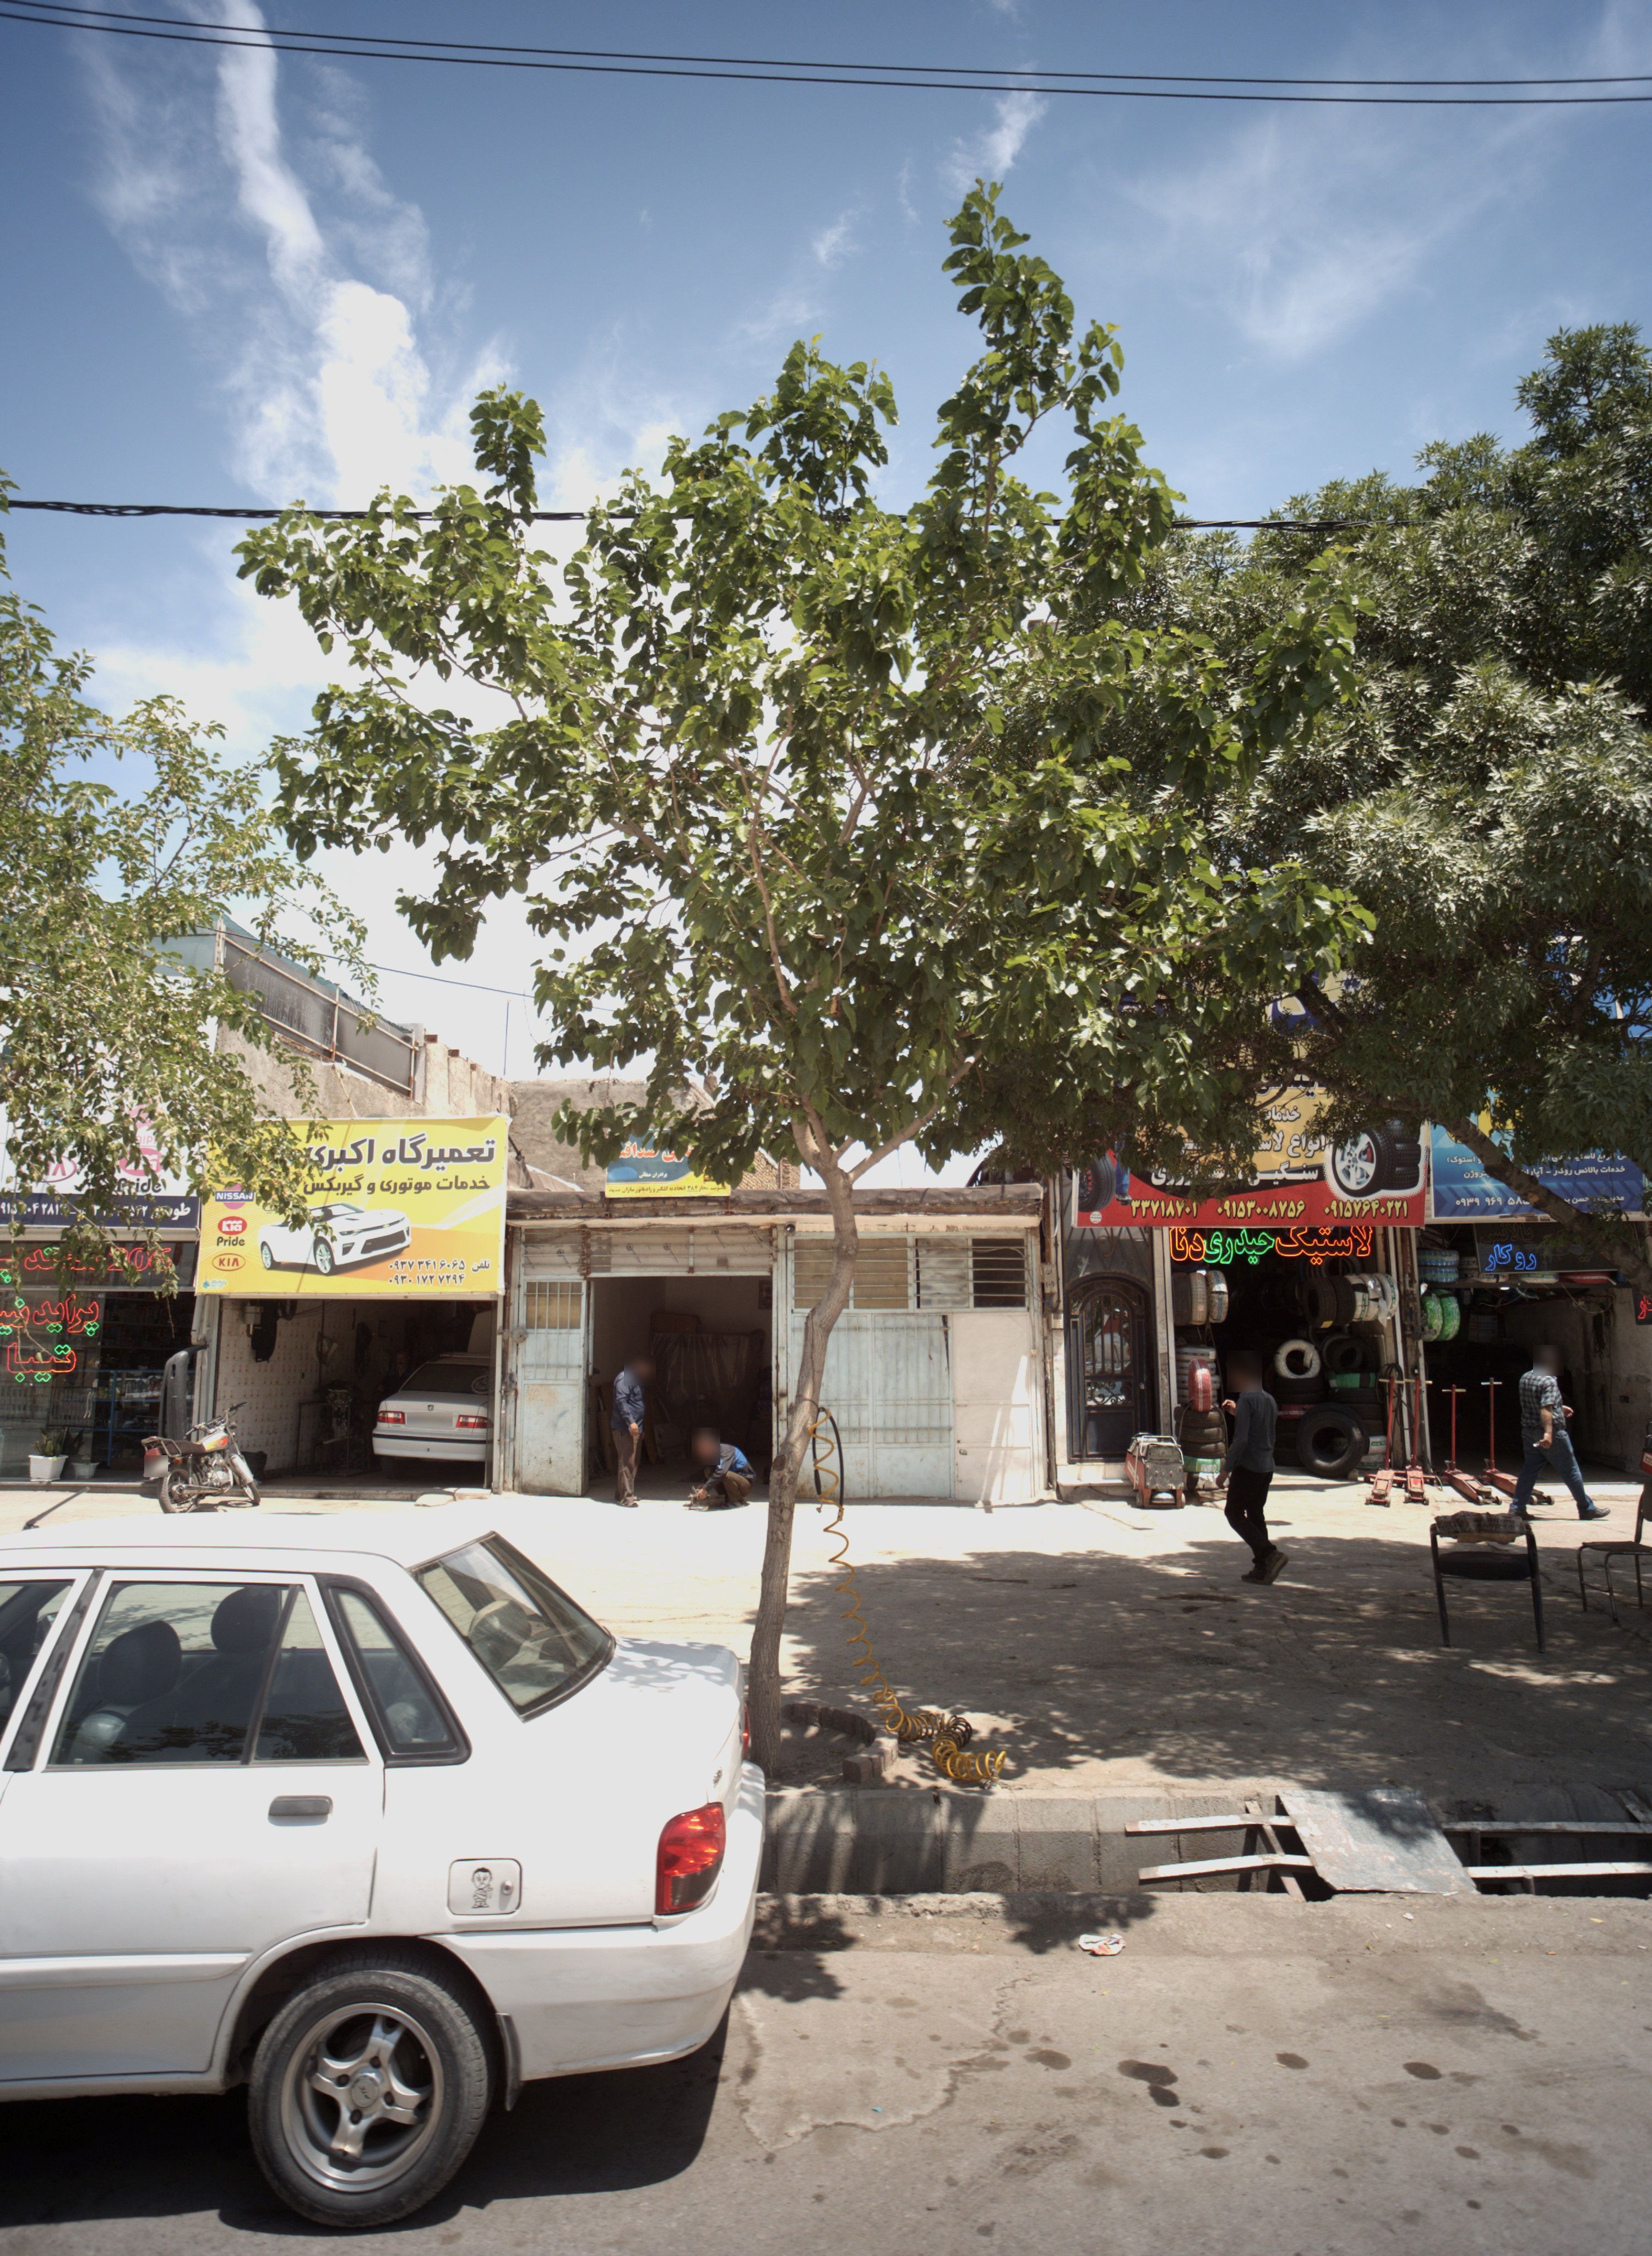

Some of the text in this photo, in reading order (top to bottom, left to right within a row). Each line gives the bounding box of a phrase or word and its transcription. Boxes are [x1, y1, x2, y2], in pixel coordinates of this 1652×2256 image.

[307, 1133, 495, 1172] تعمیرگاه اکبری
[1574, 1167, 1598, 1175] بالانس
[303, 1174, 490, 1196] خدمات موتوری و گیربکس
[1455, 1197, 1480, 1206] ۰۹۳۹
[1485, 1197, 1502, 1206] ۹۶۹
[1217, 1200, 1305, 1218] ۰۹۱۵۳۰۰۸۷۵۶
[1324, 1200, 1408, 1218] ۰۹۱۵۷۶۴۰۲۲۱
[216, 1237, 245, 1246] Pride
[1169, 1226, 1372, 1265] لاستیک حیدری دنا
[219, 1257, 239, 1266] KIA
[389, 1260, 490, 1272] تلفن ۰۹۳۷ ۳۴۱ ۶۰۶۵
[389, 1274, 465, 1285] ۰۹۳۰ ۱۷۲ ۷۲۹۴
[32, 1293, 100, 1337] پراید
